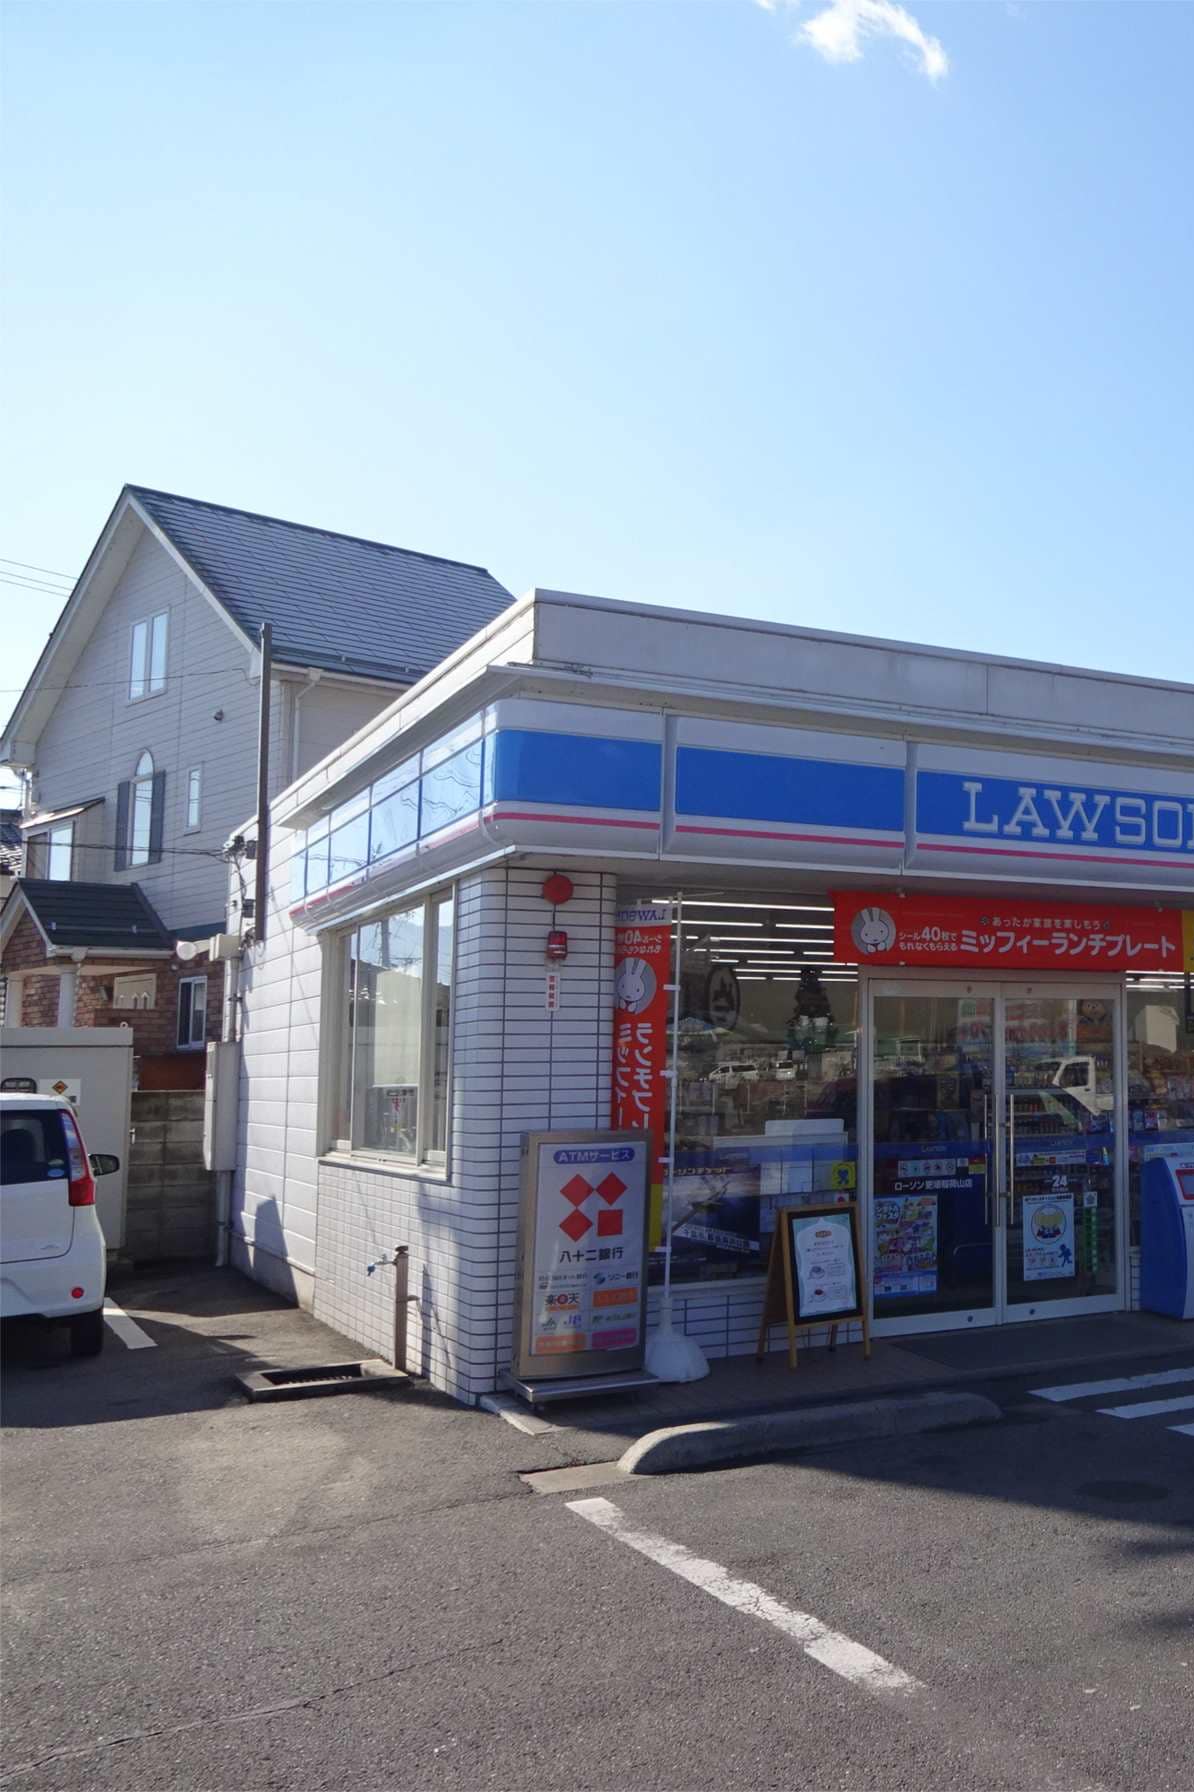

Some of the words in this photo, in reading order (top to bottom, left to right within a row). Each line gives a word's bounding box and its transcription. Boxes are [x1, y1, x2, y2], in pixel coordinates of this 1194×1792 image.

[959, 929, 1177, 958] ミッフィーランチプレート
[558, 1149, 631, 1164] ATMサービス
[1052, 1175, 1068, 1187] 24
[559, 1247, 625, 1264] 八十二銀行
